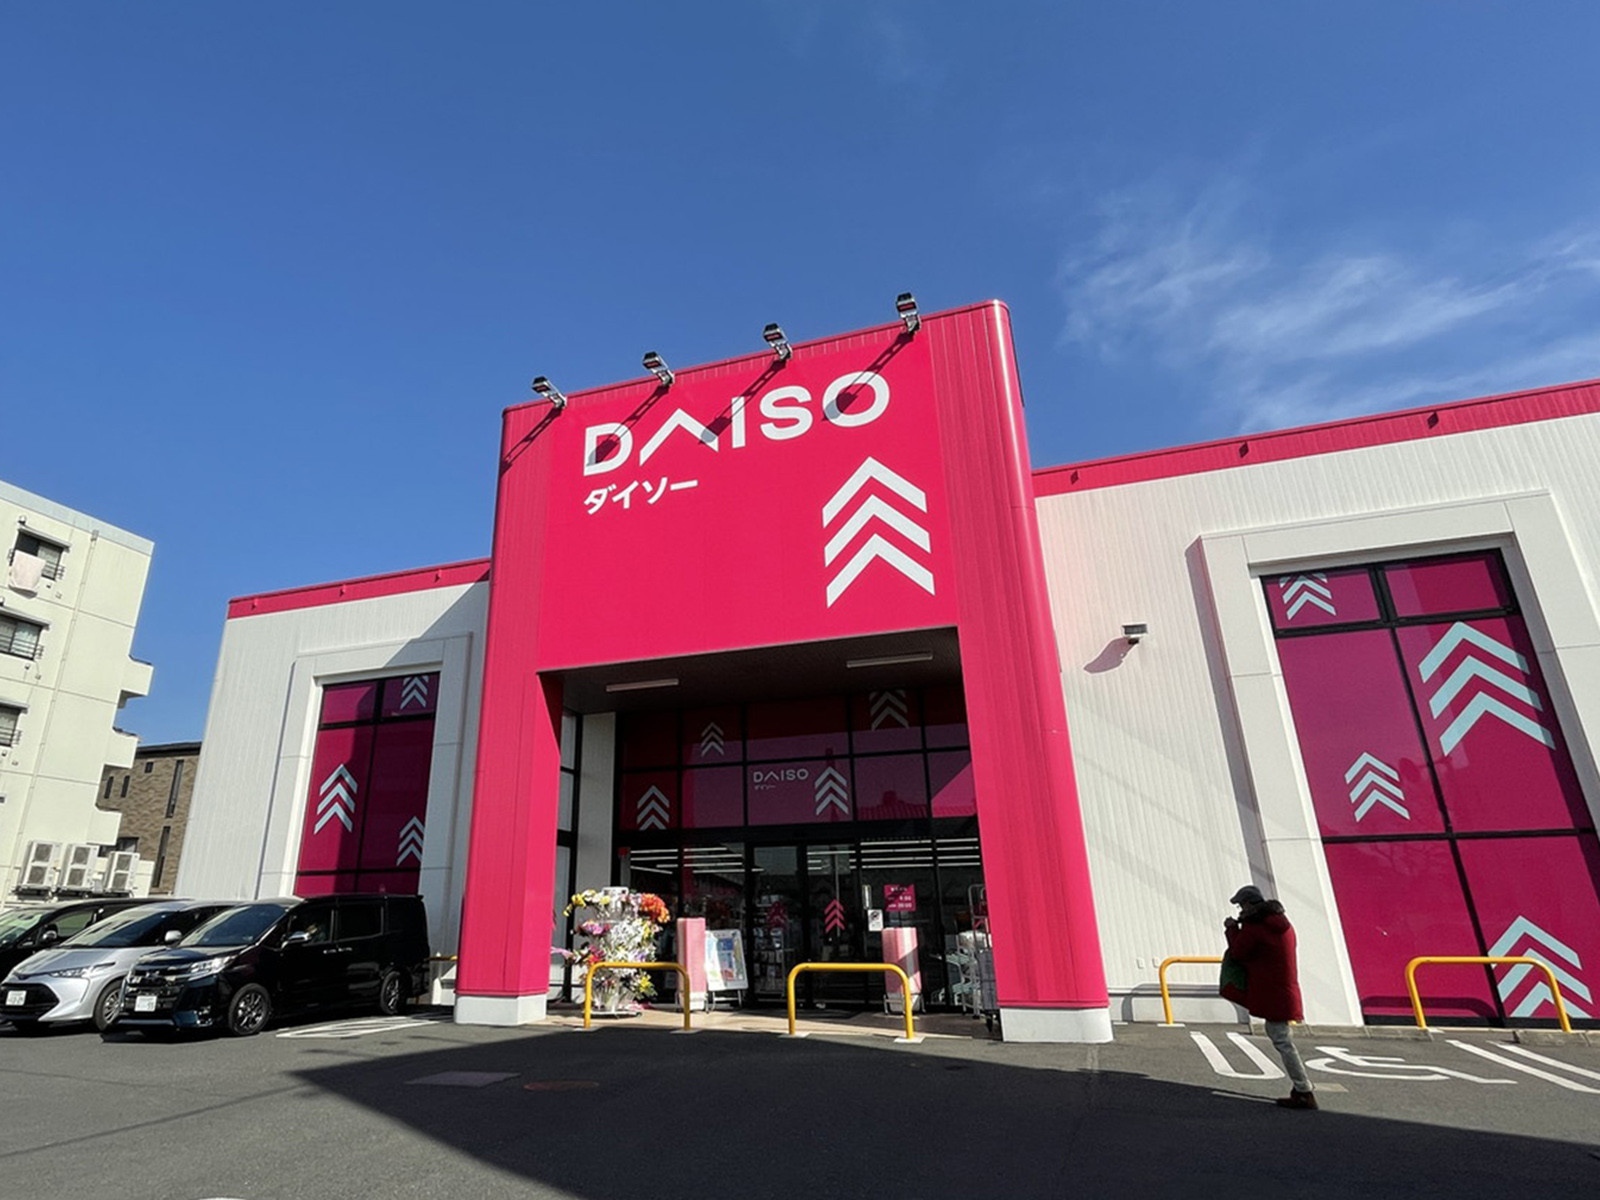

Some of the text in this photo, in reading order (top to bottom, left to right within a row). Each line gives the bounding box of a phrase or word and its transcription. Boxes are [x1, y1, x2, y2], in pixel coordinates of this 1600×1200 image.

[583, 371, 890, 476] DAISO
[583, 477, 698, 515] ダイソー
[753, 768, 809, 783] DAISO
